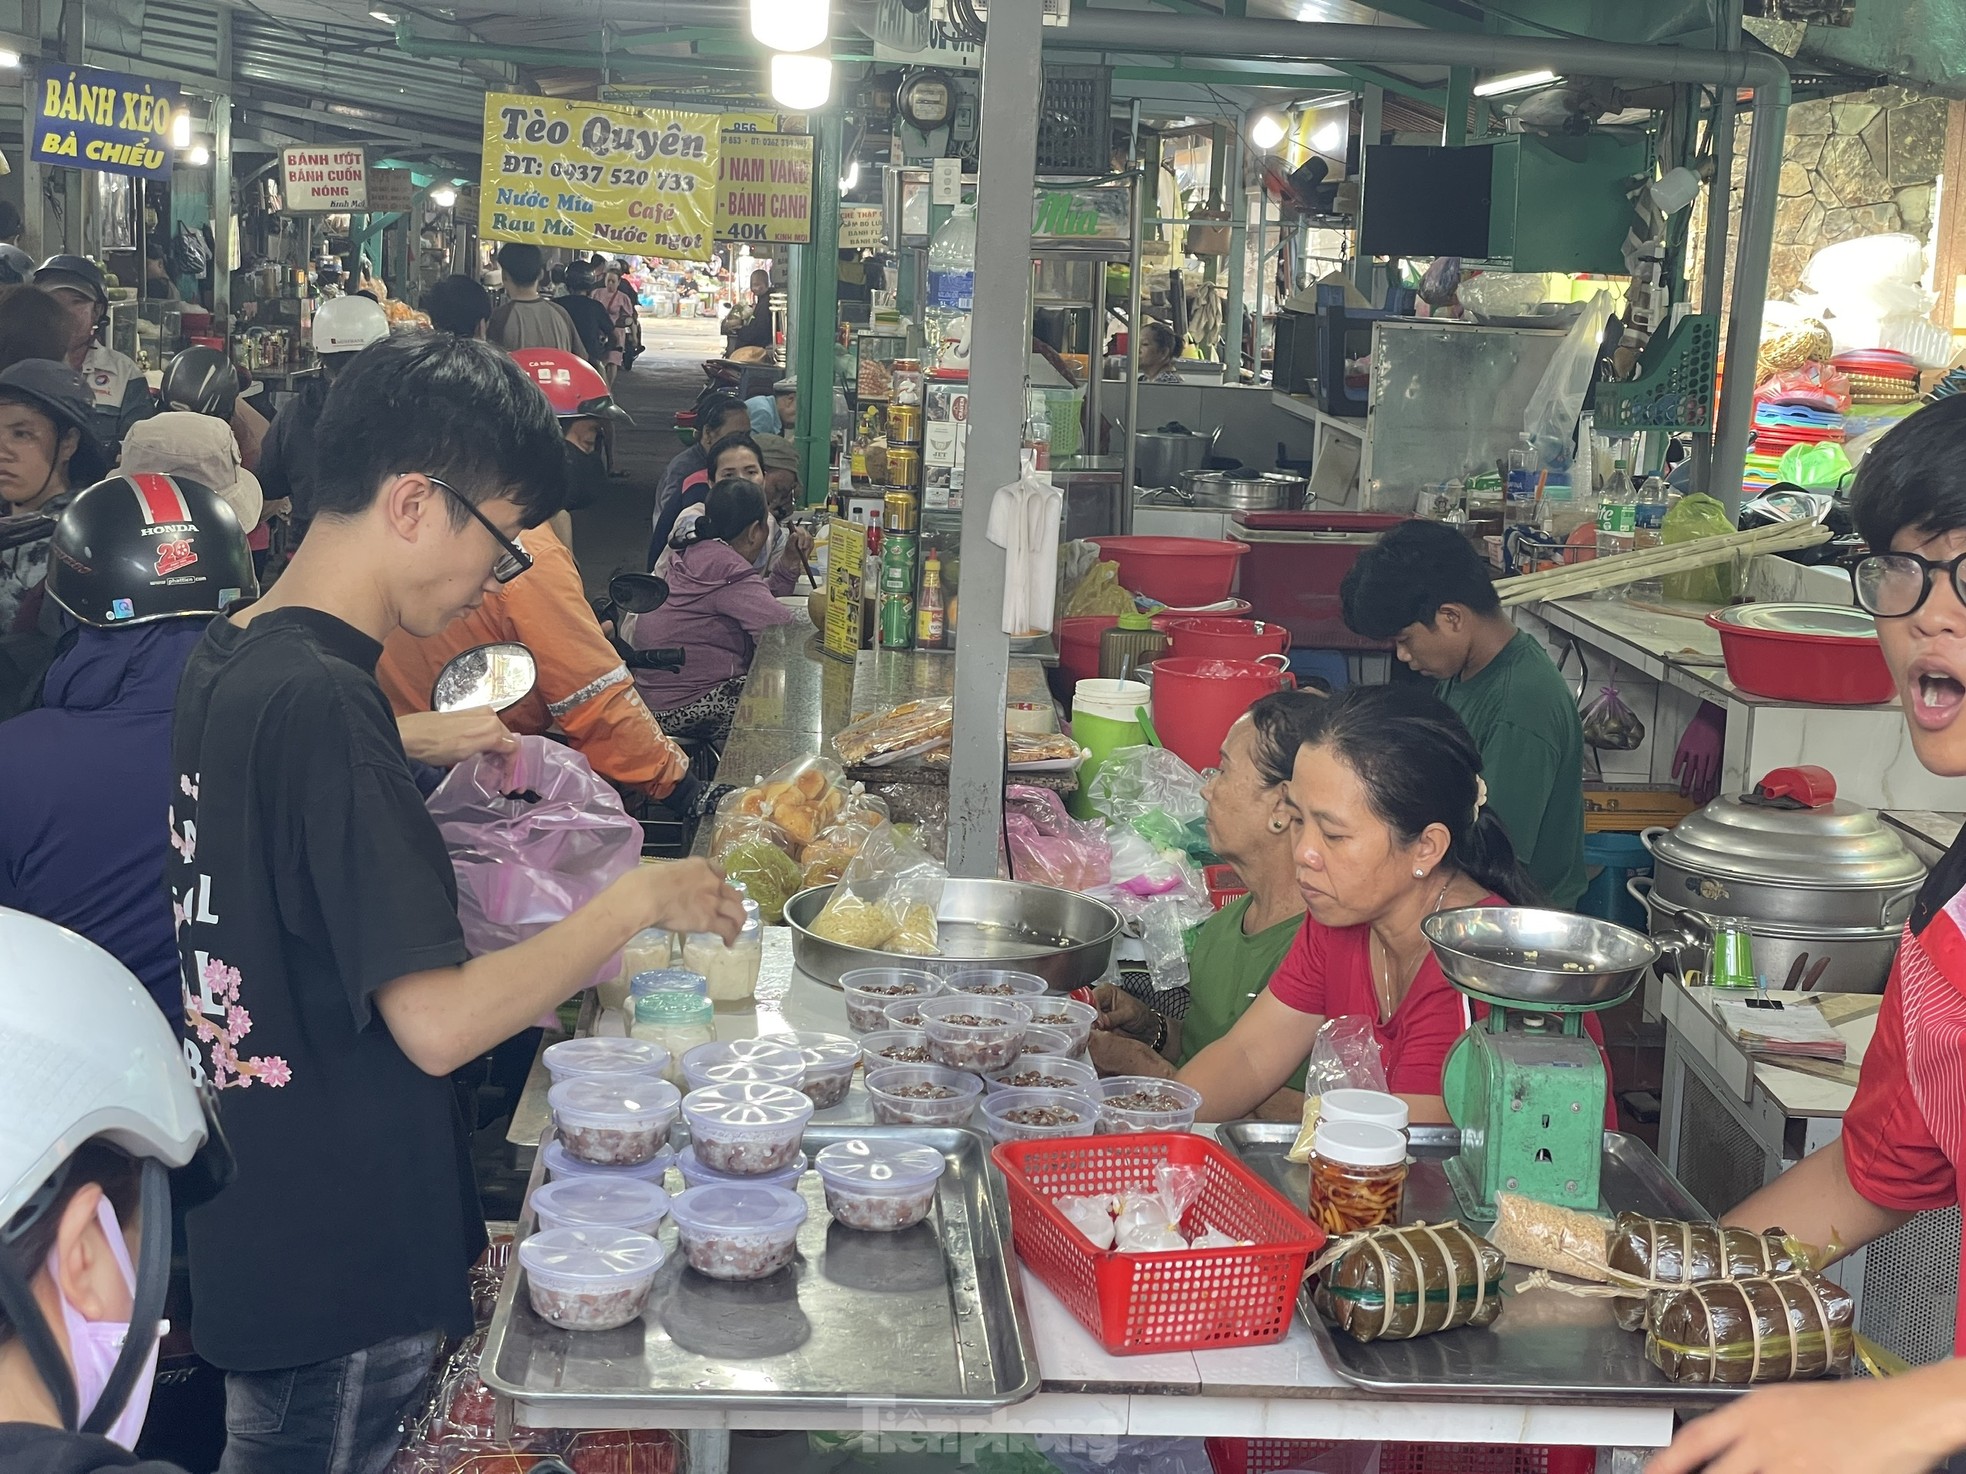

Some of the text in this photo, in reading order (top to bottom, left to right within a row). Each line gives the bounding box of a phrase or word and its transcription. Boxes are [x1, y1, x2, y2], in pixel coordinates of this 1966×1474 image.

[43, 71, 171, 135] BÁNH XÈO
[501, 107, 705, 161] Tèo Quyên
[41, 131, 165, 170] BÀ CHIỂU
[287, 151, 361, 166] BÁNH ƯỚT
[289, 166, 362, 182] BÁNH CUỐN
[502, 155, 695, 192] ĐT: 0937 520 733
[730, 157, 764, 182] NAM
[311, 184, 349, 196] NÓNG
[496, 187, 550, 208] Nước
[555, 193, 594, 213] Mía
[628, 200, 675, 224] Café
[729, 187, 807, 219] BÁNH CANH
[492, 213, 535, 232] Rau
[593, 223, 648, 243] Nước
[655, 230, 703, 252] ngọt
[728, 222, 767, 240] 40K
[140, 524, 200, 537] HONDA
